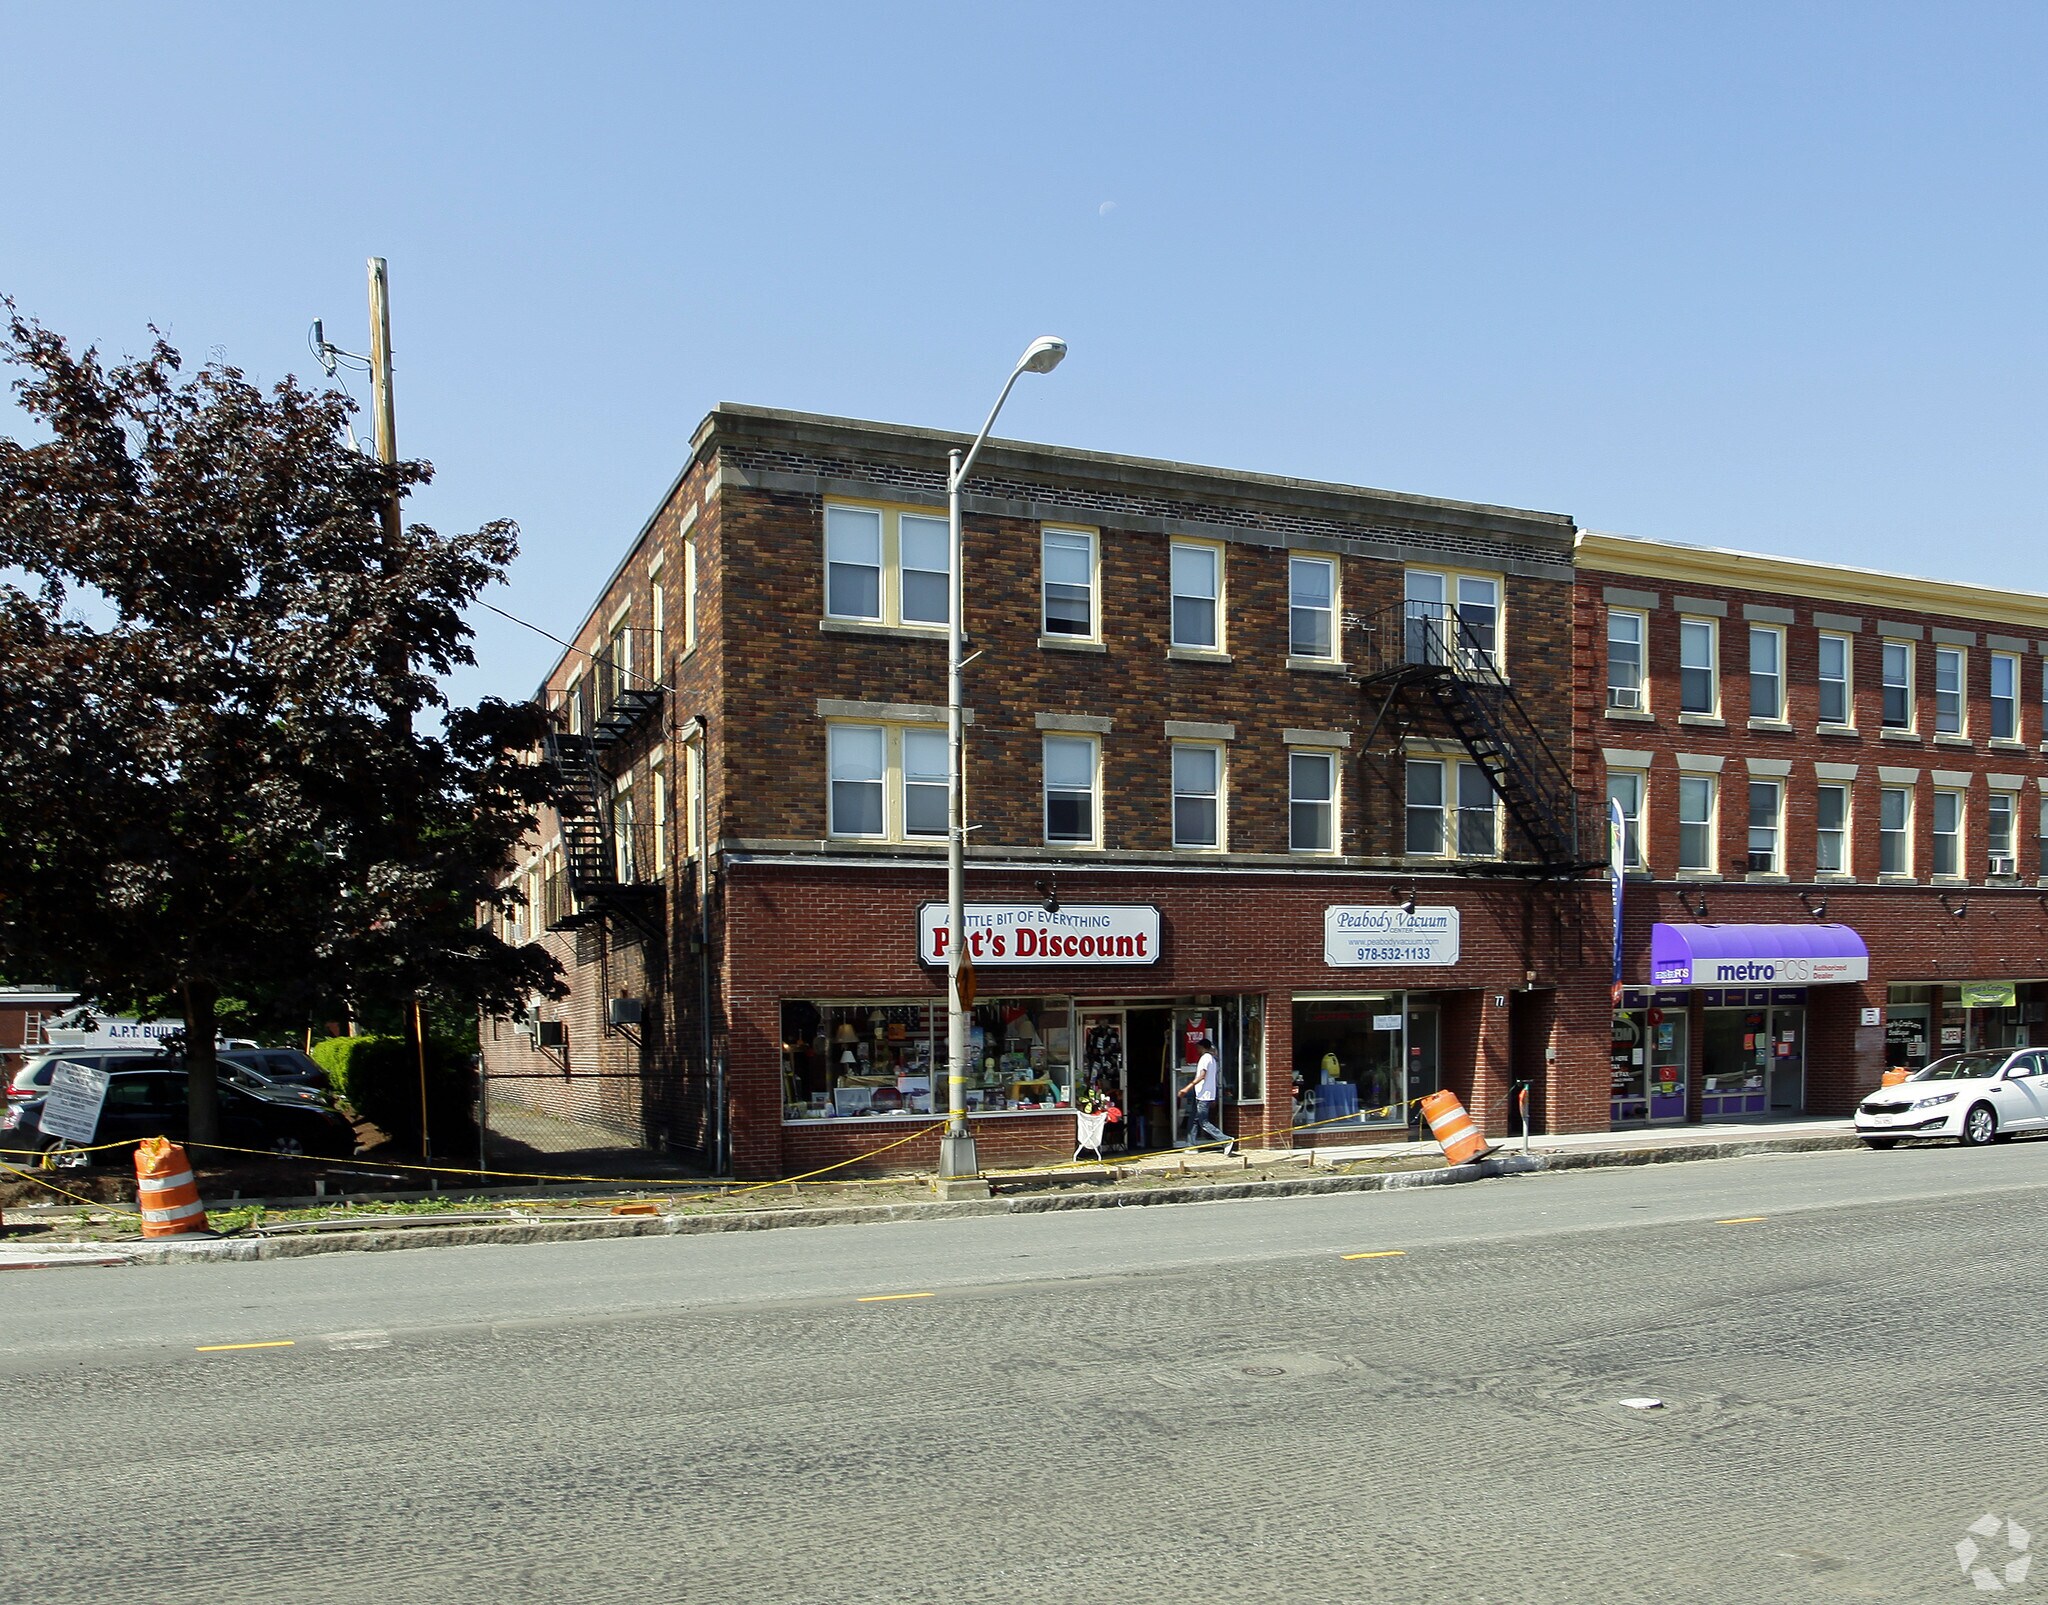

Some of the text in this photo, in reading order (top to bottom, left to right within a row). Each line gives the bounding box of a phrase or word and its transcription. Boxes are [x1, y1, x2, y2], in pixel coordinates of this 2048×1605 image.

[963, 915, 992, 927] ITTLE
[997, 912, 1014, 925] BIT
[1017, 911, 1034, 923] OF
[1038, 911, 1111, 927] EVERYTHING
[1337, 910, 1447, 932] Peabody Vacuum
[932, 927, 1147, 957] Pt's Discount
[1348, 938, 1439, 946] www.peabodyvacuum.com
[1357, 948, 1430, 960] 978-532-1133
[1717, 960, 1808, 981] metroPCS
[1813, 964, 1847, 972] Authorized
[1813, 972, 1834, 980] Dealer
[1494, 995, 1504, 1007] 77
[109, 1025, 140, 1038] A.P.T.
